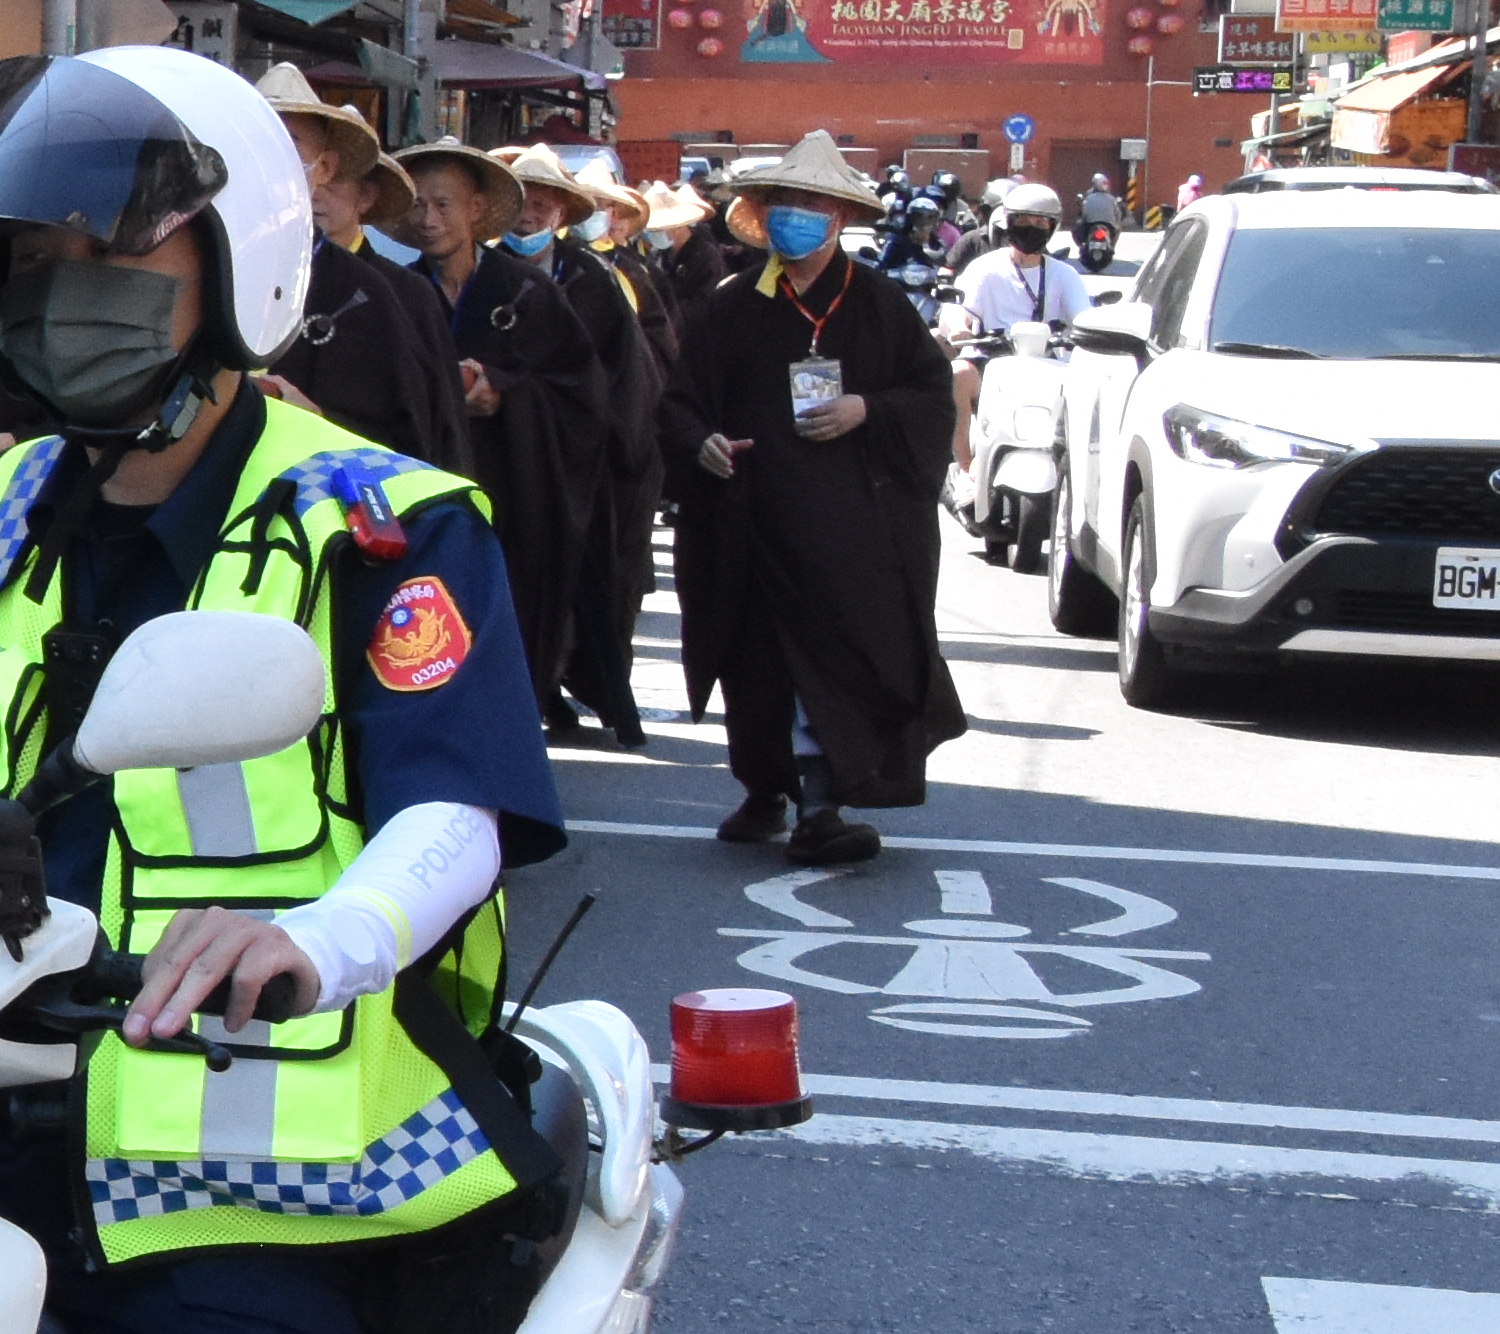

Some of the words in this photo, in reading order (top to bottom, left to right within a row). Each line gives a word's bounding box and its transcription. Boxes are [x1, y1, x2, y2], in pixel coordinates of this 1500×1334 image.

[832, 23, 895, 36] TAOYUAN
[957, 23, 1007, 36] TEMPLE
[411, 655, 456, 685] 03204
[407, 806, 481, 890] POLICE
